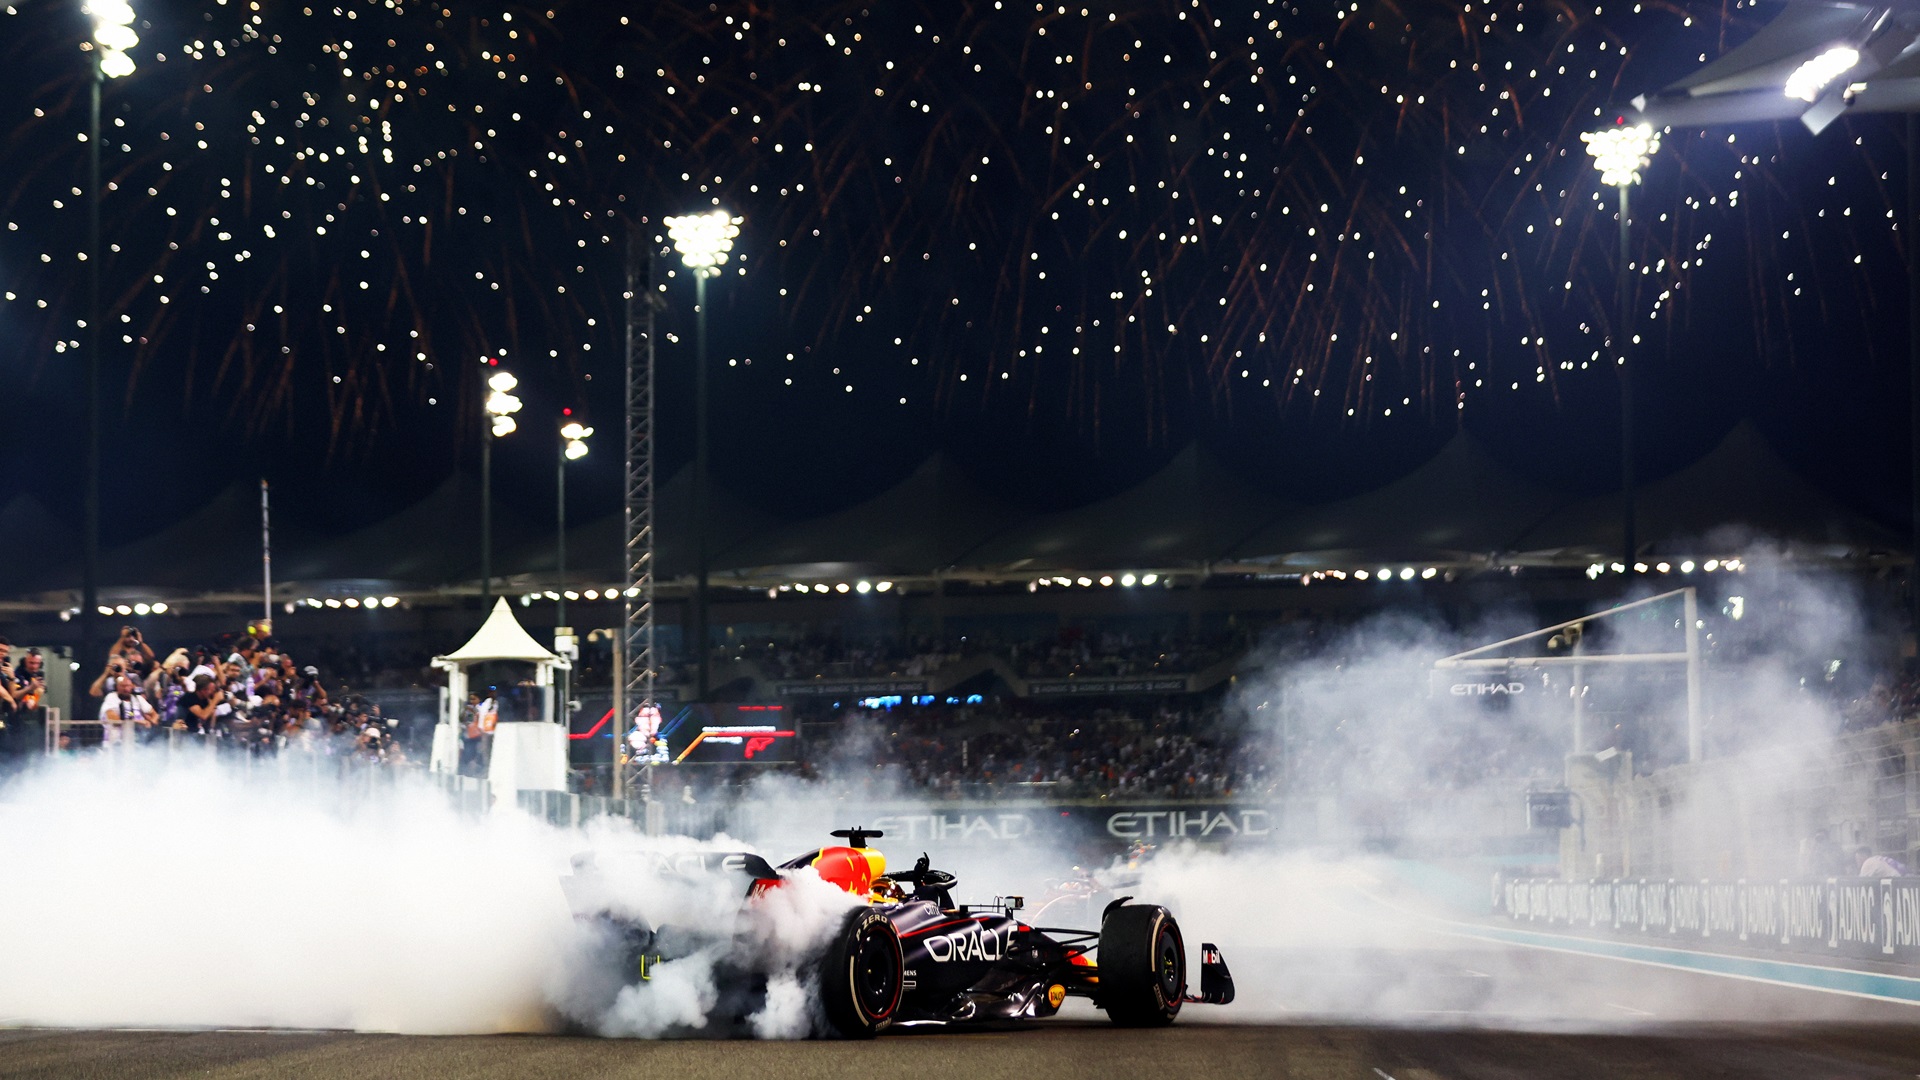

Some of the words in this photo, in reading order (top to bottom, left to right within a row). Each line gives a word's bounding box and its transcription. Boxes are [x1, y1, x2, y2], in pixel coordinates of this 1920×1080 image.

[1450, 682, 1525, 696] ETIHAD
[872, 814, 1031, 840] ETIHAD
[1106, 810, 1274, 838] ETIHAD
[861, 914, 888, 930] ZERO
[1790, 885, 1823, 938] ADNOC
[1838, 886, 1876, 944] ADNOC
[1896, 887, 1920, 946] ADN
[923, 925, 1018, 963] ORACLE
[1202, 949, 1221, 965] Mobil
